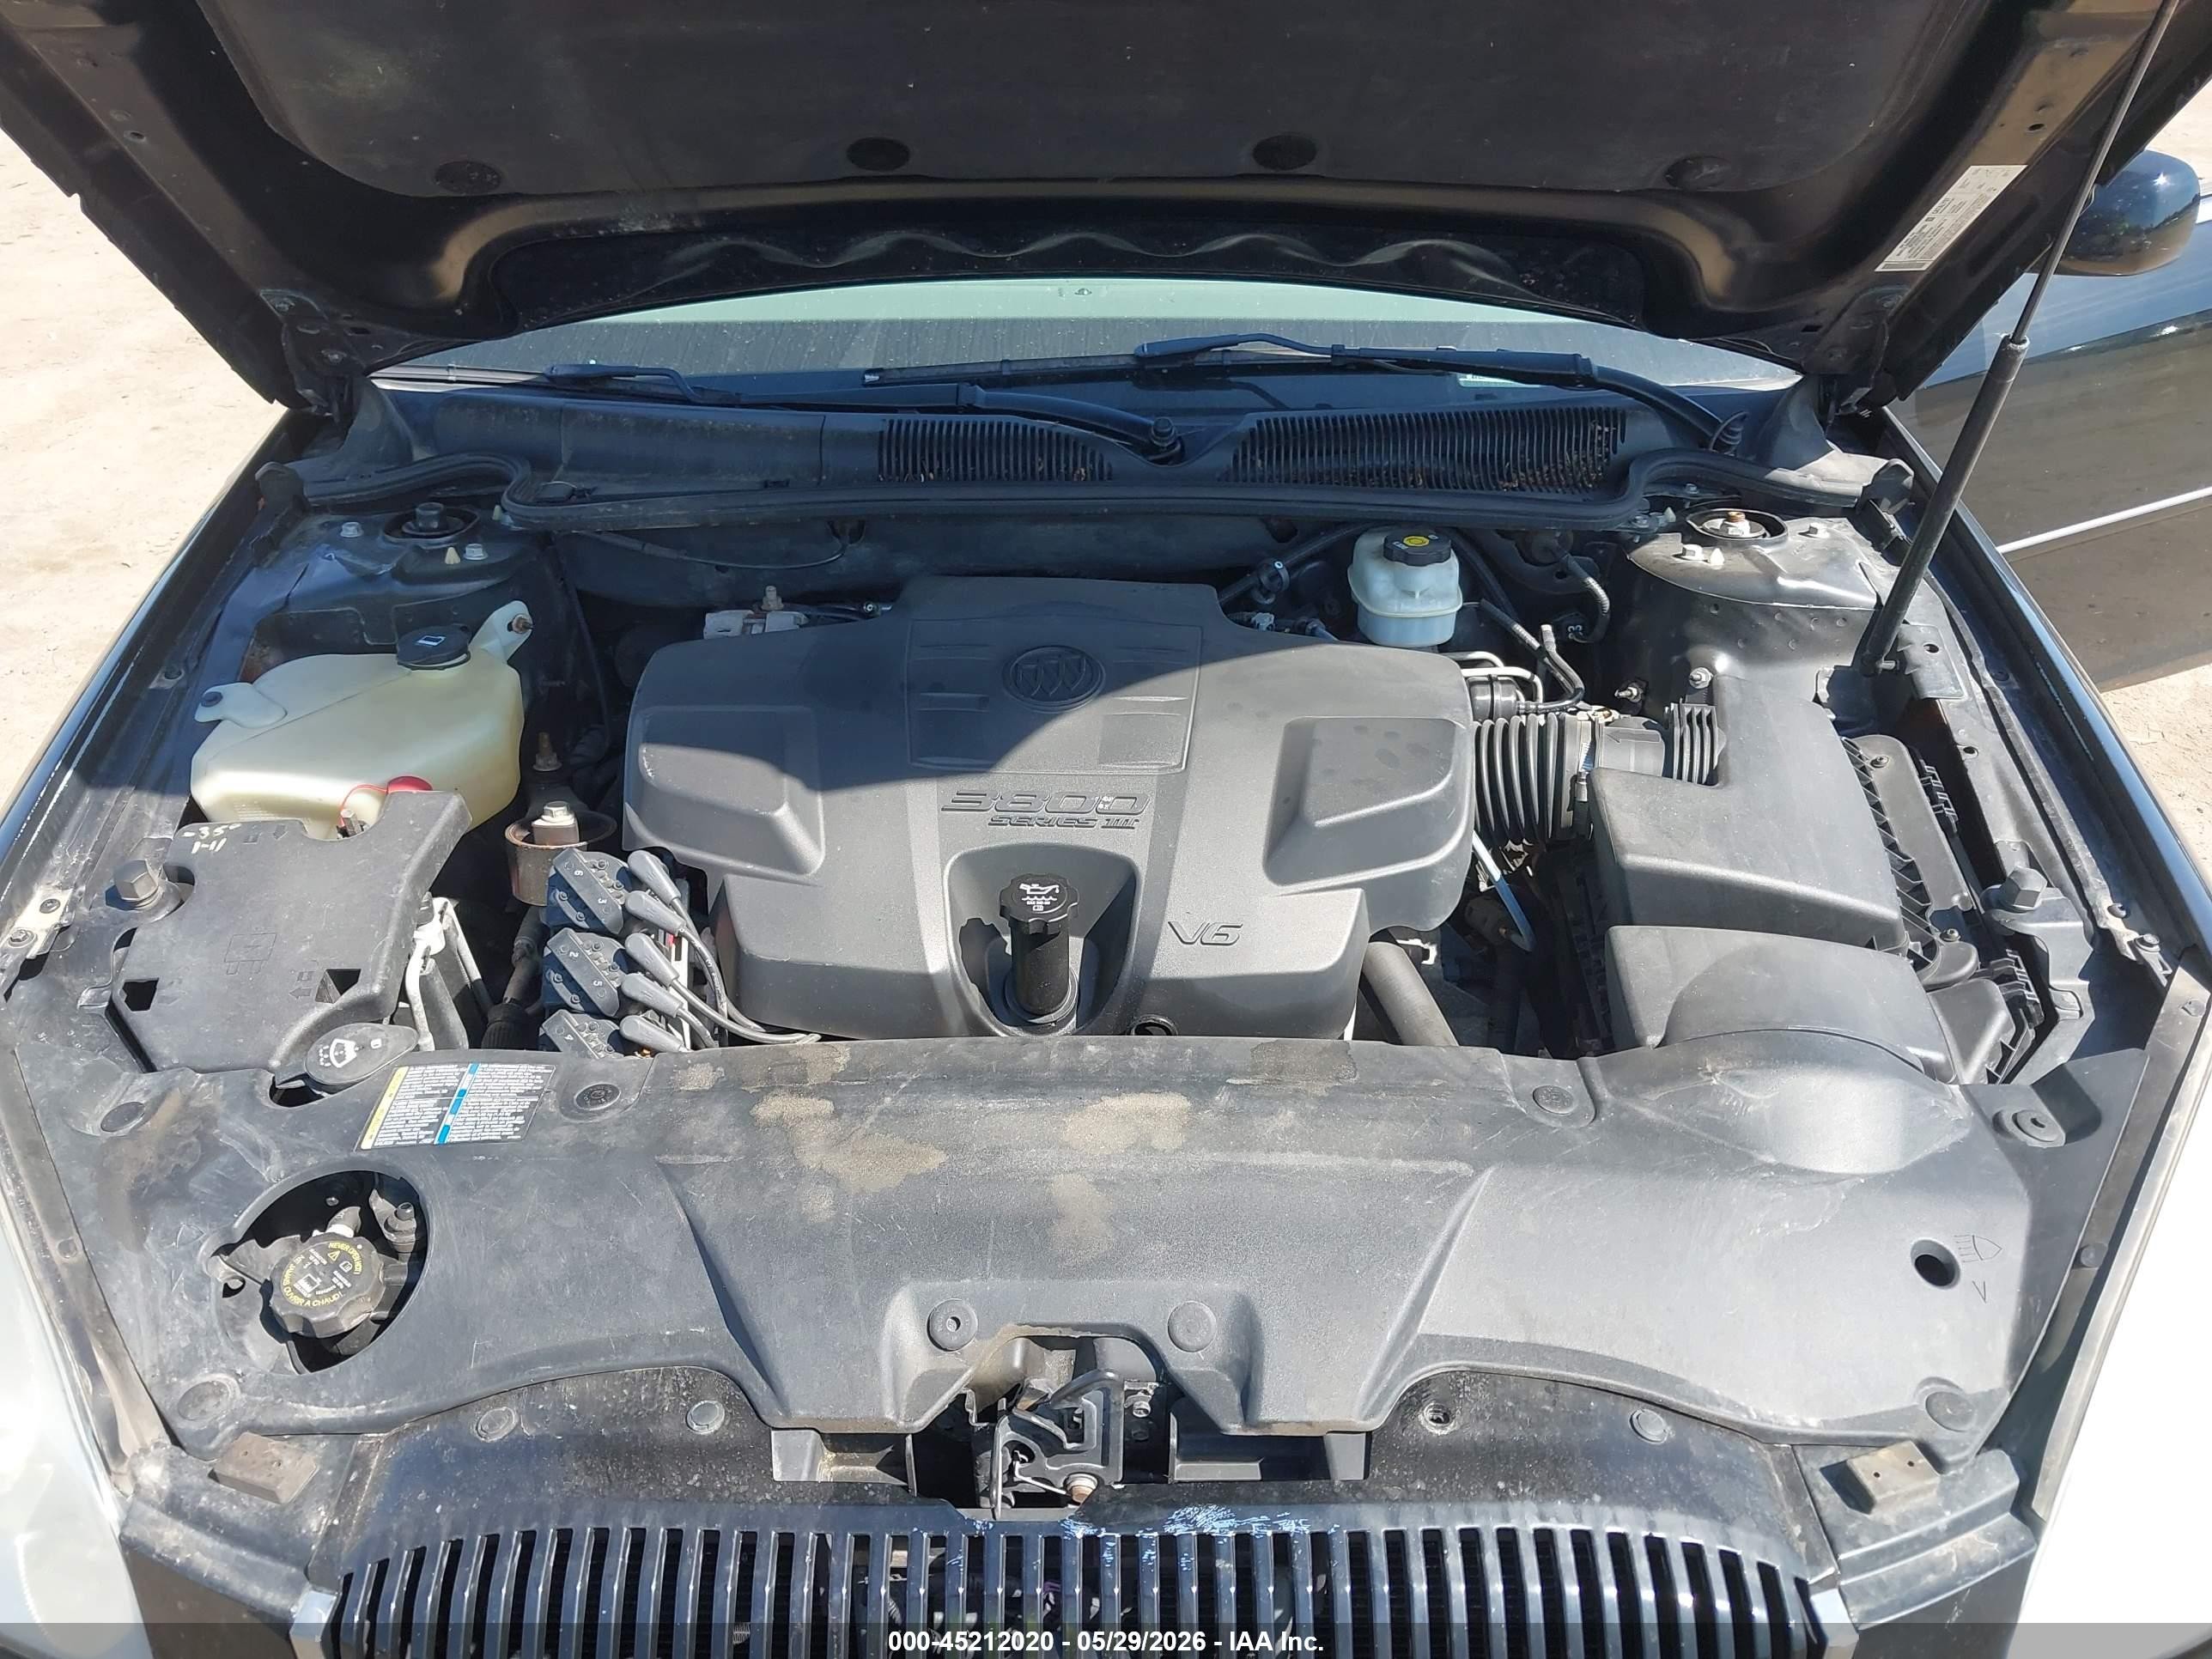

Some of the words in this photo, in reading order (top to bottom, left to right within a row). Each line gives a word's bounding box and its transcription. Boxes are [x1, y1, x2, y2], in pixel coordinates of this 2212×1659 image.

[941, 790, 1151, 815] 3800
[988, 816, 1098, 828] SERIES
[1101, 817, 1140, 830] III
[1168, 921, 1243, 945] V6
[328, 1242, 350, 1251] NEVER
[348, 1248, 361, 1262] OPEN
[283, 1286, 305, 1306] OUVRIR
